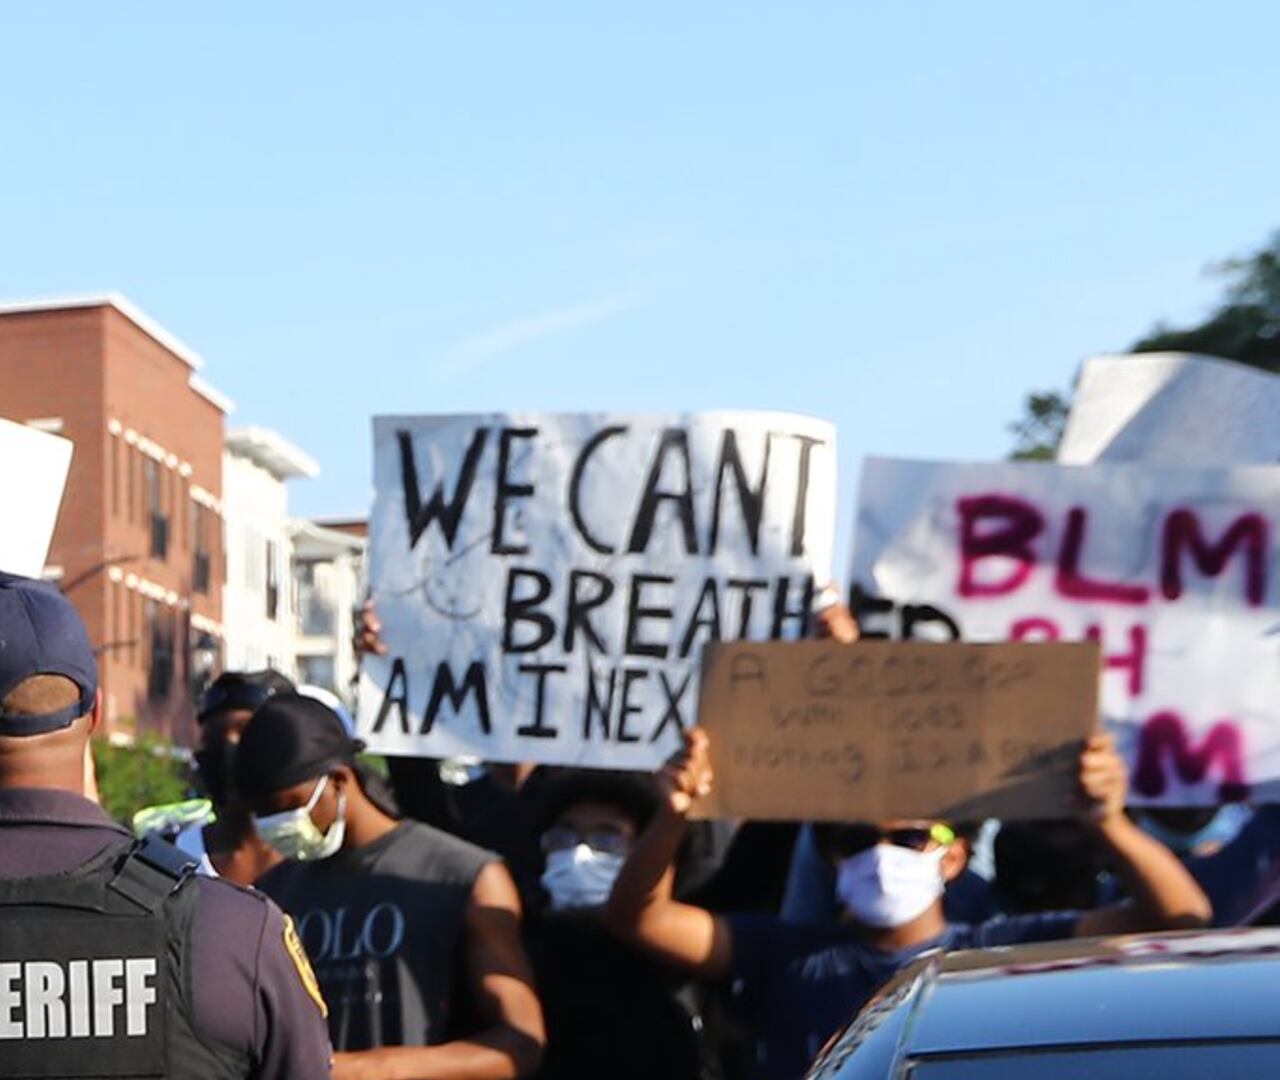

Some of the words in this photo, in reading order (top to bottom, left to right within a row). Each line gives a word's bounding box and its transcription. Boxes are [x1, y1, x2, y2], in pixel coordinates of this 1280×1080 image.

[396, 428, 538, 555] WE
[955, 490, 1270, 607] BLM
[373, 657, 490, 735] AM
[516, 664, 566, 738] I
[730, 653, 766, 692] A
[299, 901, 406, 960] OLO
